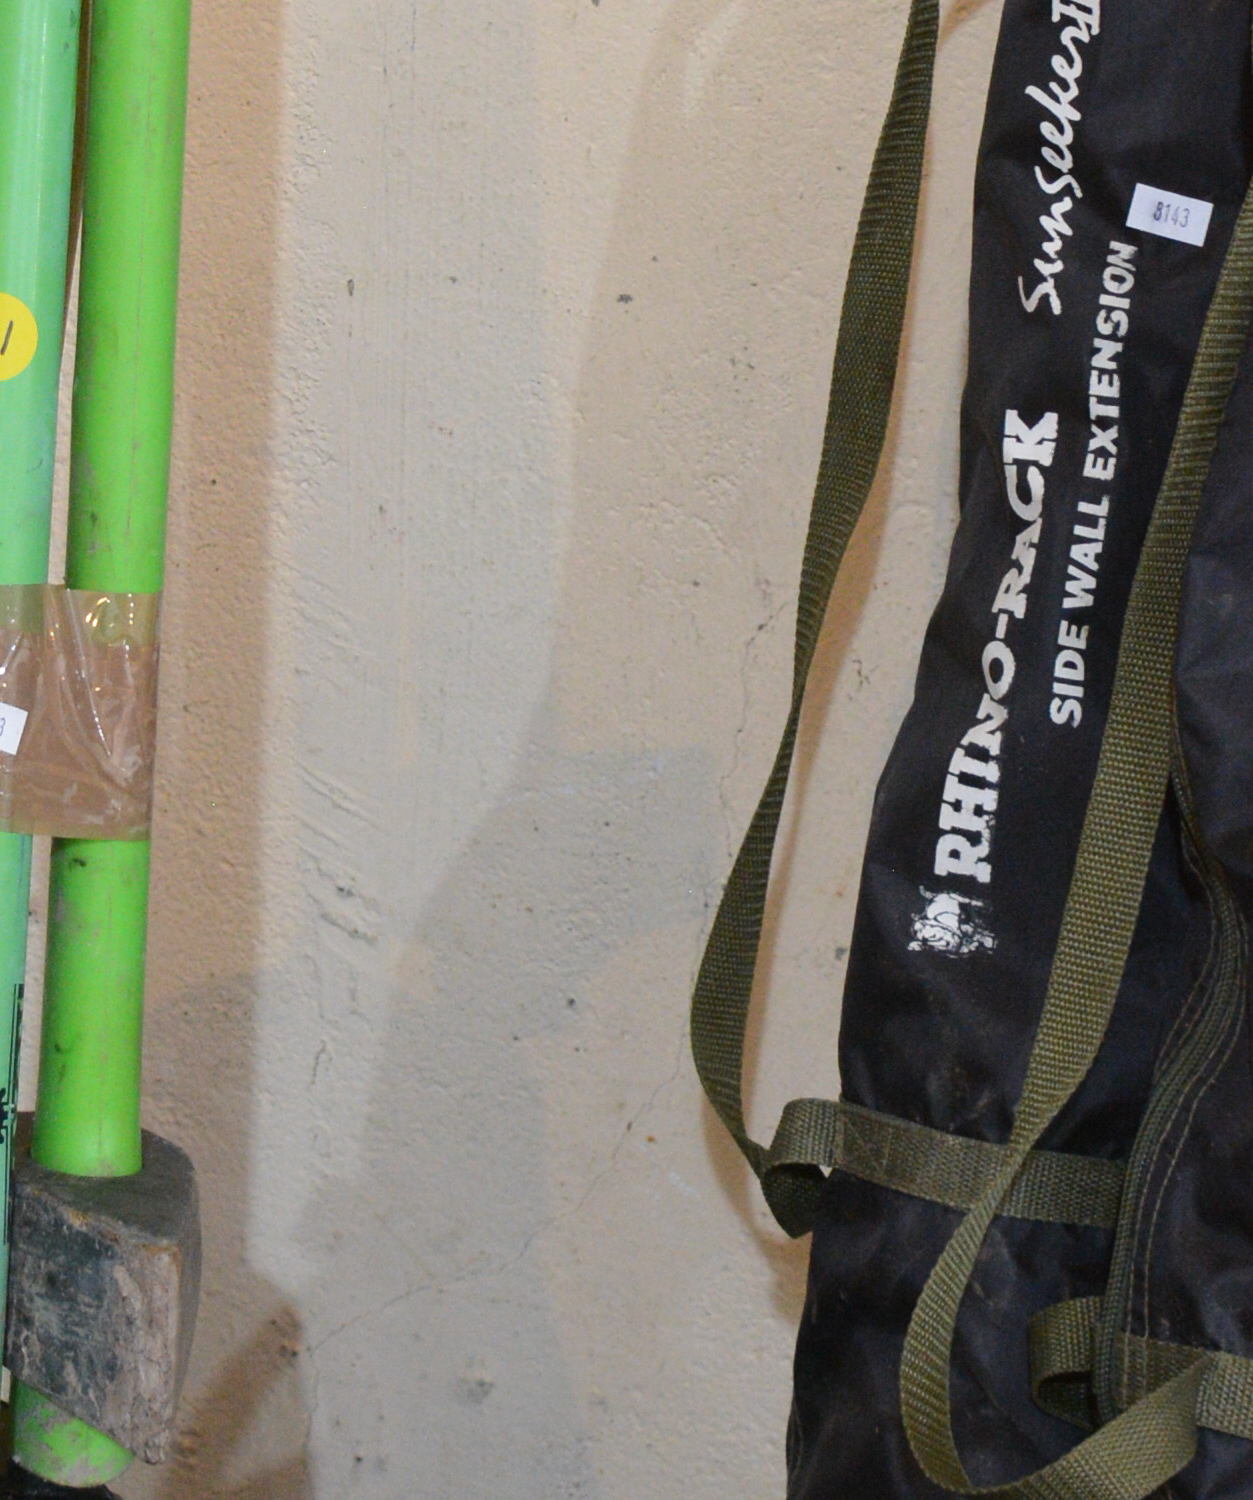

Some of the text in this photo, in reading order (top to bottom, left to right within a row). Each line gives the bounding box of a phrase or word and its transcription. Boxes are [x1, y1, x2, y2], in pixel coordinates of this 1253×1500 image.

[1153, 201, 1191, 228] 8143
[933, 408, 1059, 884] RHINO-RACK
[1048, 240, 1139, 728] SIDE WALL EXTENSION
